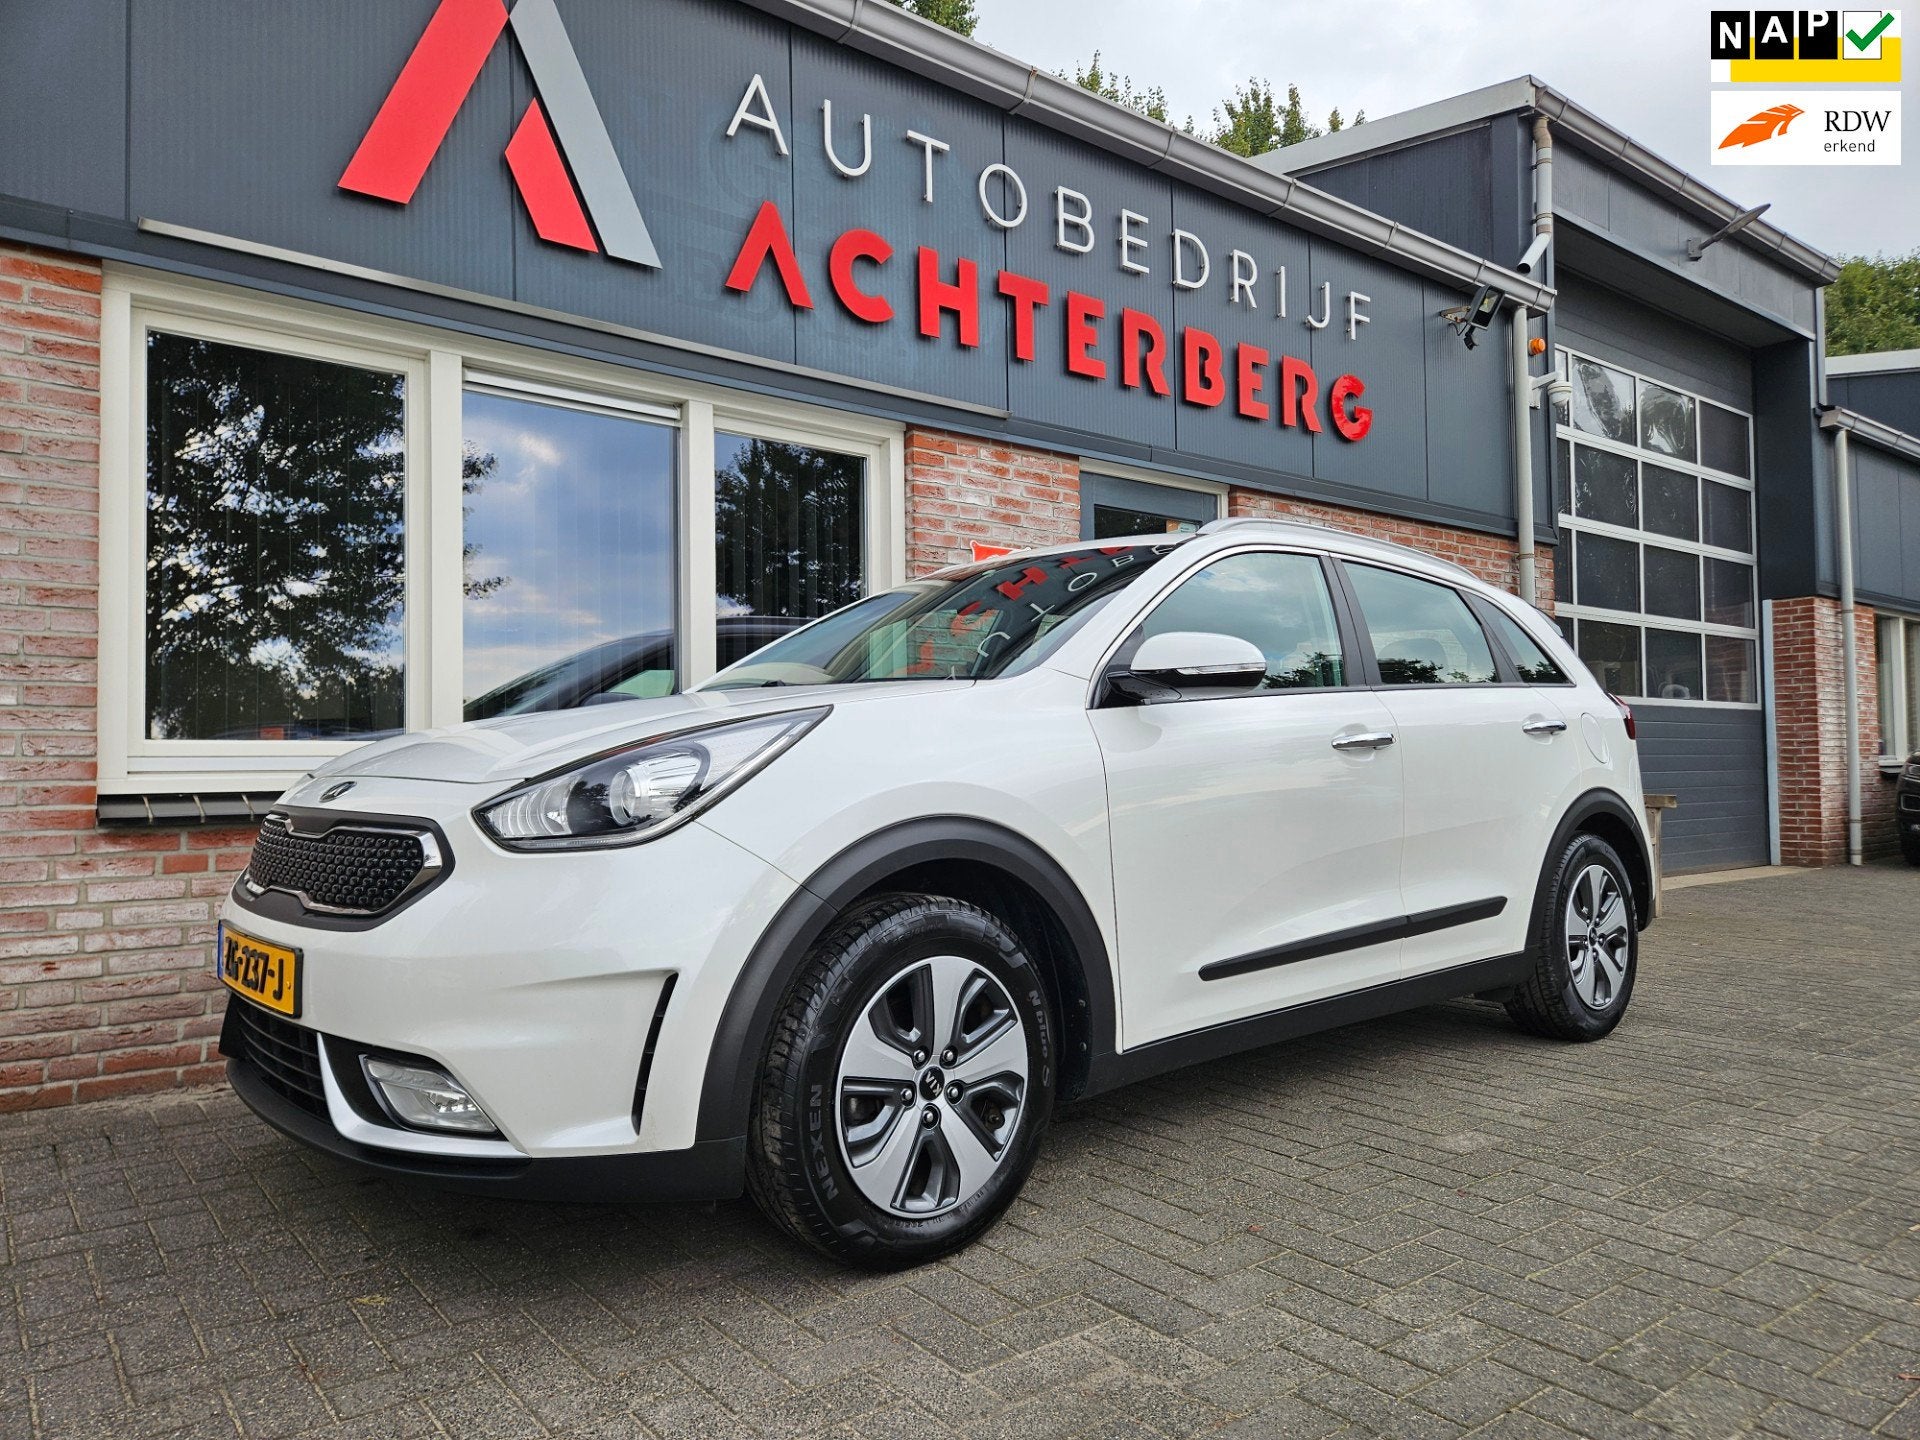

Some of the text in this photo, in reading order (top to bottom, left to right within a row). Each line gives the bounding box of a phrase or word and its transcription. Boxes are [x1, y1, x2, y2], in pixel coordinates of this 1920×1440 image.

[724, 200, 1374, 443] ACHTERBERG
[726, 74, 1372, 340] AUTOBEDRIJF
[809, 1084, 839, 1200] NEXEN
